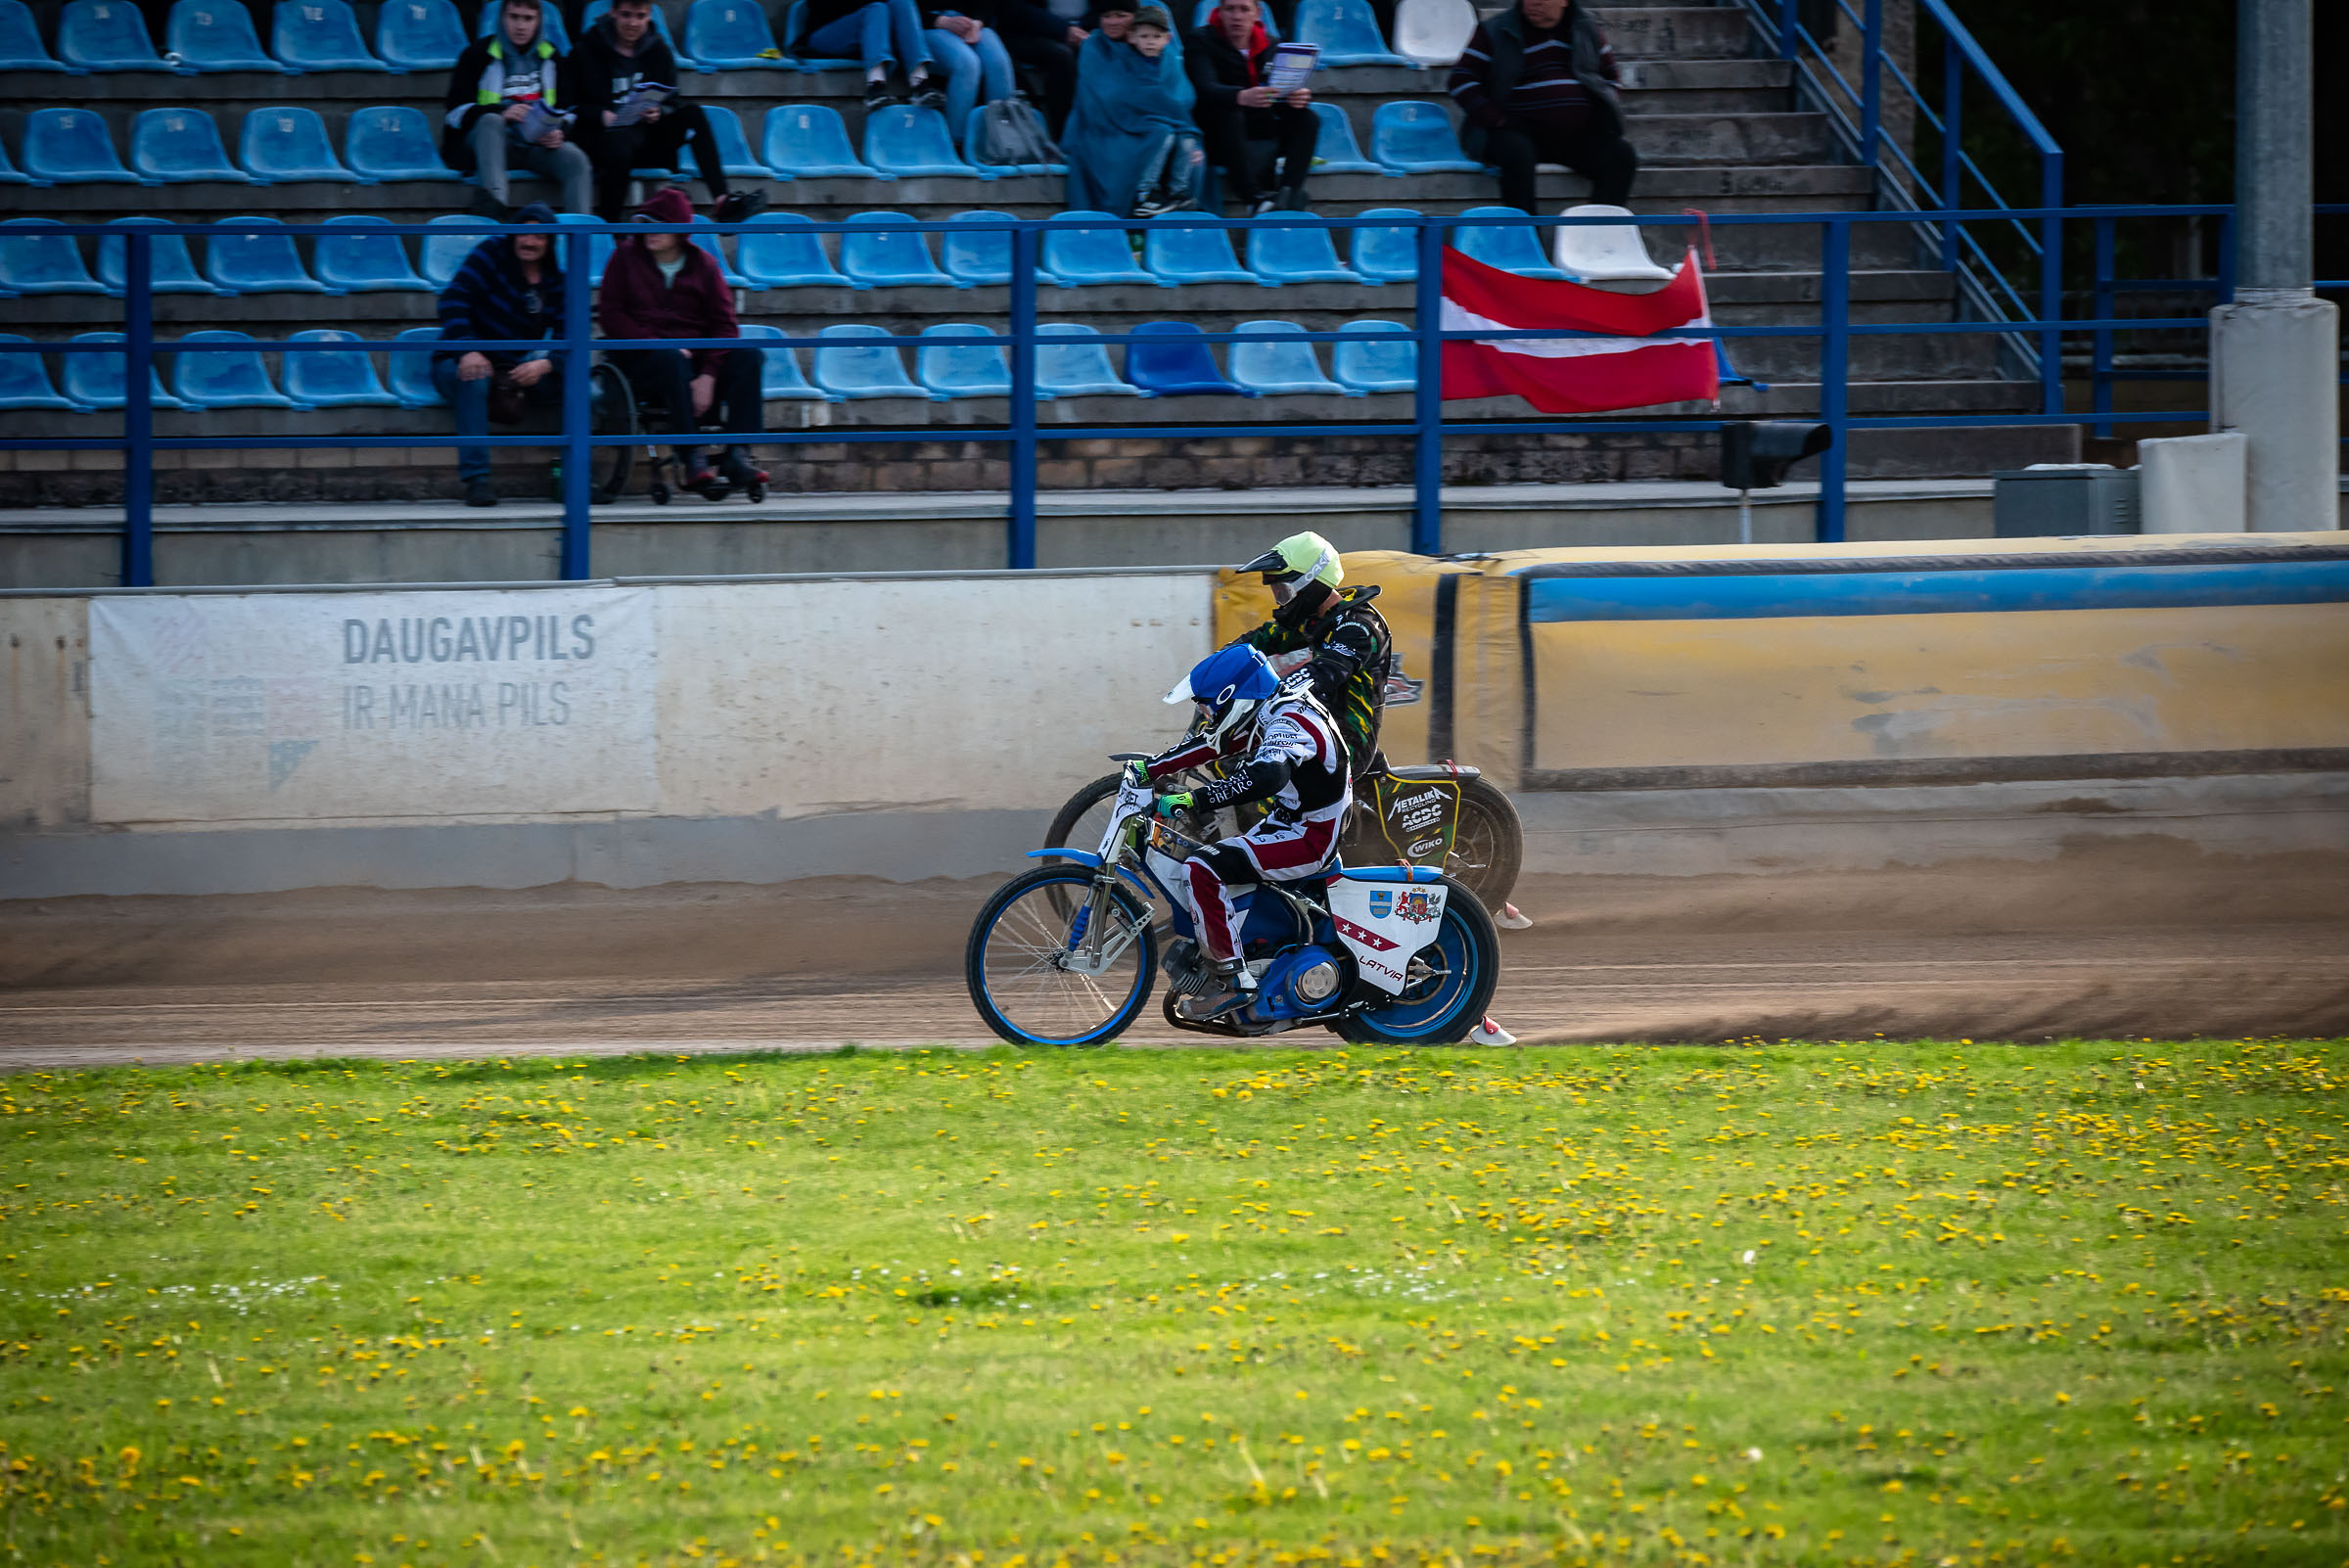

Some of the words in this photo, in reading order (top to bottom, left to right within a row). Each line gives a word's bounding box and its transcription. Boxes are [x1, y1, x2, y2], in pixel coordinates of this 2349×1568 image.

[343, 614, 596, 665] DAUGAVPILS
[344, 684, 375, 729] IR
[391, 683, 486, 729] MANA
[497, 680, 572, 726] PILS
[1215, 781, 1249, 804] BEAR
[1388, 786, 1453, 821] METALIKA
[1402, 804, 1443, 829] ACDC
[1414, 838, 1443, 853] WIKO
[1359, 955, 1404, 982] LATVIA
